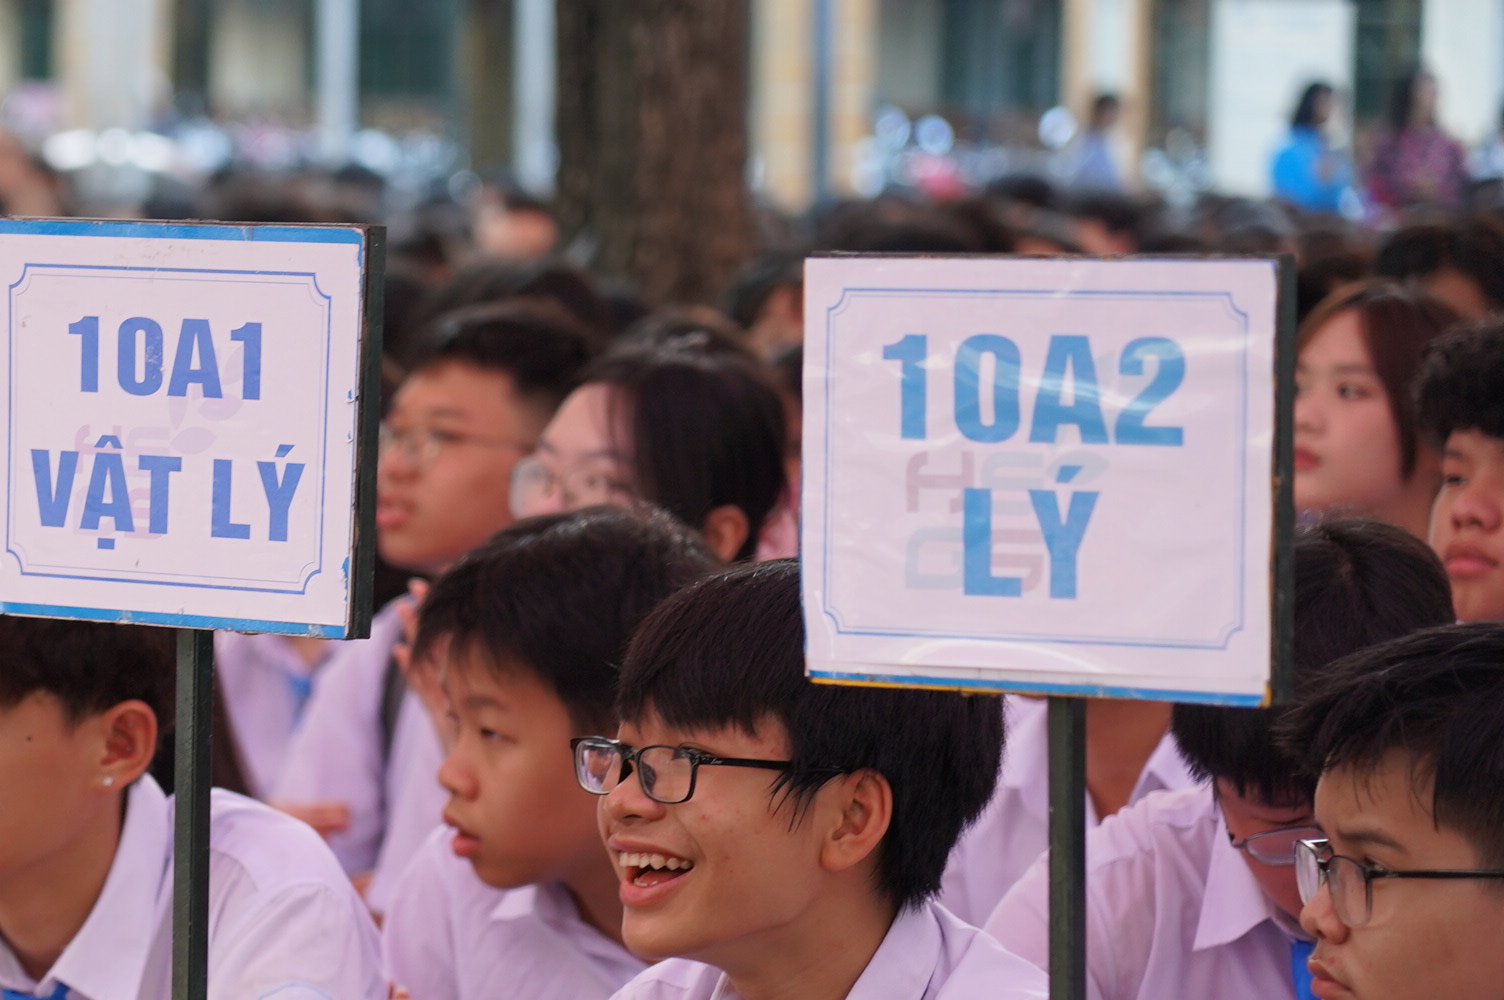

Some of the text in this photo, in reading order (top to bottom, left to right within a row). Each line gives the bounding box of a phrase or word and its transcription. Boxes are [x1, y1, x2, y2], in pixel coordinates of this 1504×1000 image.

[68, 316, 262, 401] 10A1
[882, 334, 1186, 447] 10A2
[31, 435, 183, 550] VẬT
[210, 444, 305, 542] LÝ
[962, 465, 1100, 600] LÝ
